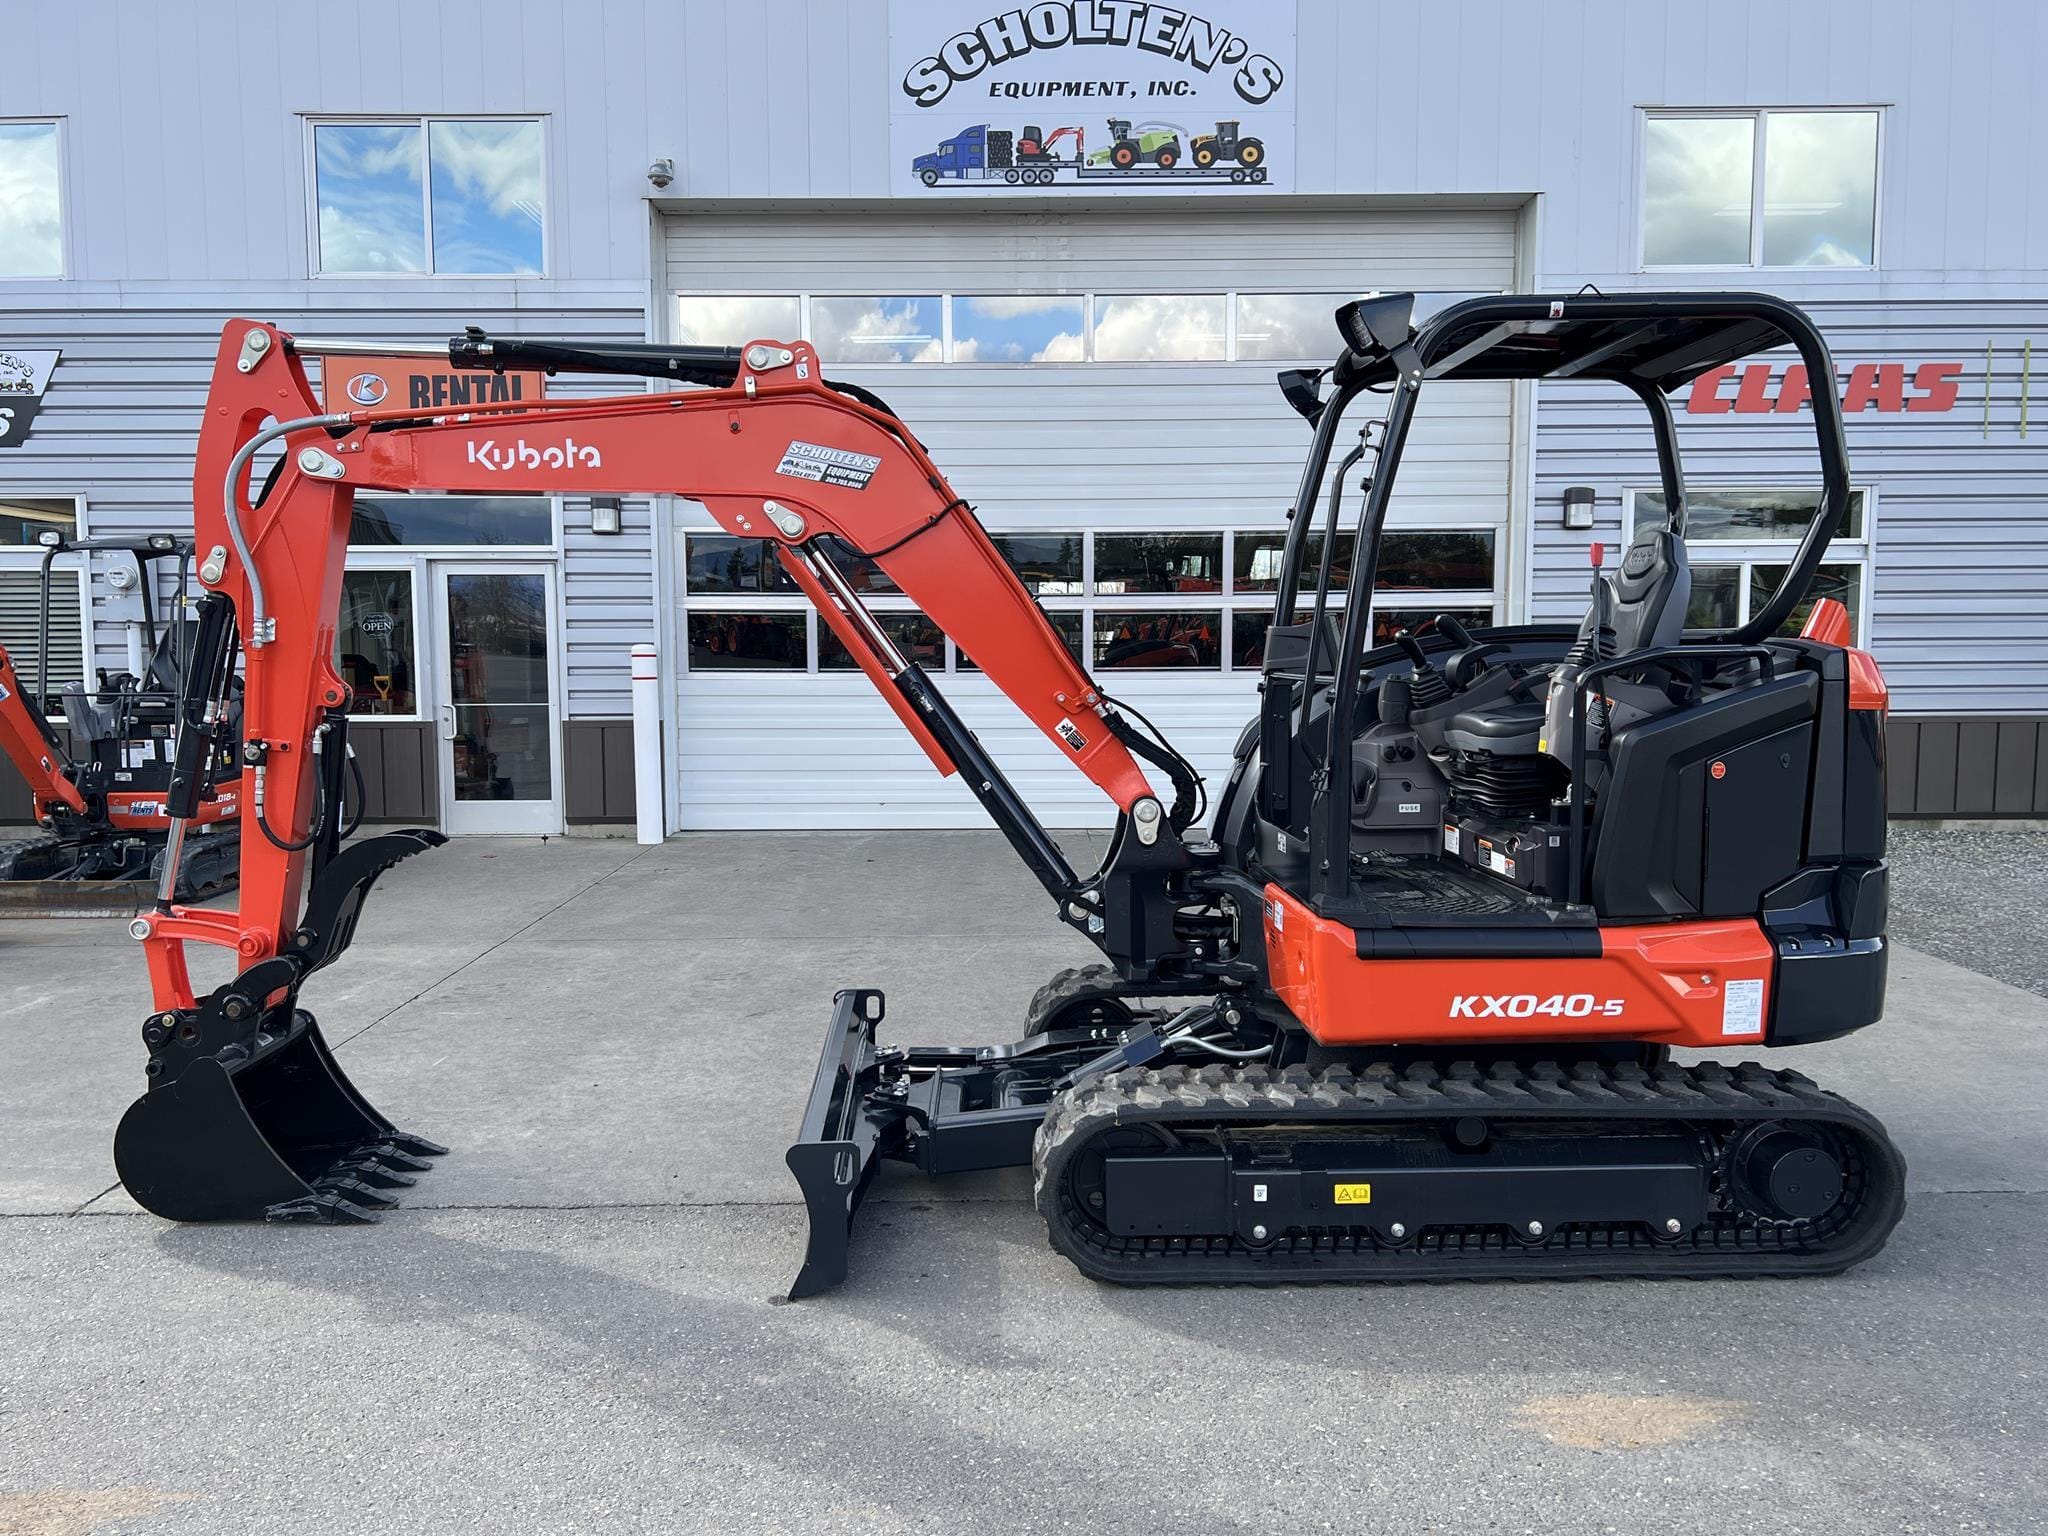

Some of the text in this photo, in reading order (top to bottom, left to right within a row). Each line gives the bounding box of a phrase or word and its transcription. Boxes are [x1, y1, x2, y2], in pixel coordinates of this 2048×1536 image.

[903, 0, 1284, 107] SCHOLTEN'S
[989, 79, 1197, 100] EQUIPMENT, INC.
[409, 374, 527, 415] RENTAL
[1686, 364, 1963, 413] CLAAS
[467, 438, 601, 471] Kubota
[789, 443, 878, 470] SCHOLTEN'S
[826, 466, 872, 482] EQUIPMENT
[363, 622, 391, 631] OPEN
[1449, 994, 1625, 1017] KX040-5
